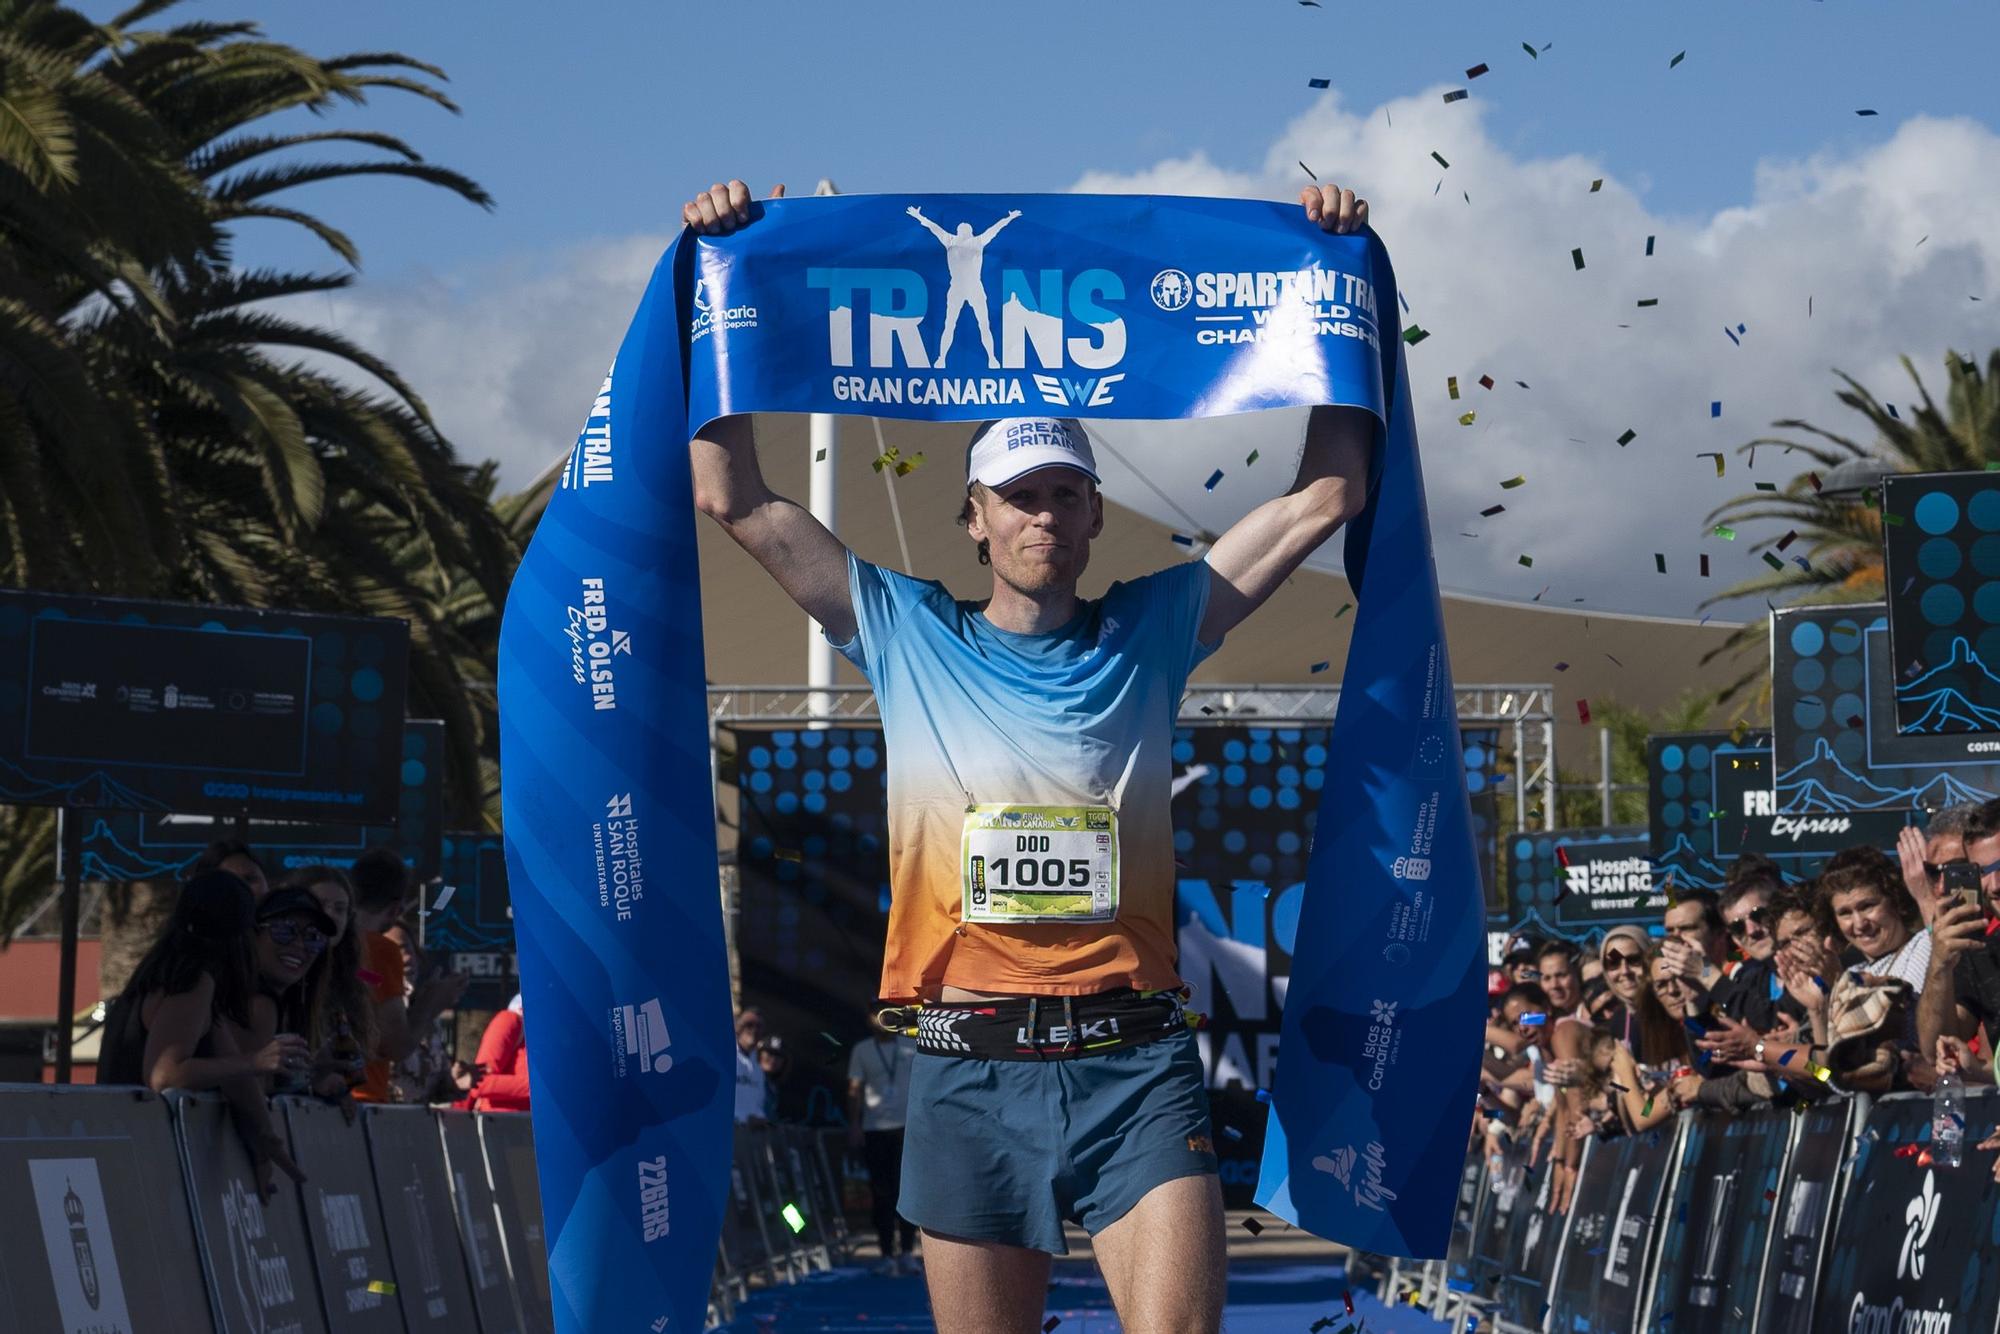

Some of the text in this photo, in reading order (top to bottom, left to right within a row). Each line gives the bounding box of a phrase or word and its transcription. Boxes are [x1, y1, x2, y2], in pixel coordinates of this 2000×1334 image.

[1195, 270, 1336, 308] SPARTAN
[832, 373, 1126, 407] GRAN CANARIA SWE
[1007, 422, 1071, 439] GREAT
[1007, 433, 1077, 451] BRITAIN
[583, 423, 613, 488] TRAIL
[564, 605, 588, 685] Express
[1967, 741, 2000, 753] COSTA
[1022, 812, 1044, 821] GRAN
[1023, 820, 1056, 829] CANARIA
[1410, 802, 1428, 855] Gobierno
[1425, 791, 1440, 841] Canarias
[1770, 815, 1851, 842] Express
[624, 819, 644, 901] Hospitales
[1016, 835, 1050, 852] DOD
[592, 822, 609, 908] UNIVERSITARIOS
[608, 821, 632, 922] SAN ROQUE
[990, 858, 1090, 887] 1005
[1590, 875, 1626, 894] SAN
[1386, 901, 1402, 940] Canarias
[1398, 905, 1411, 941] avanza
[1408, 891, 1423, 926] Europa
[612, 1006, 627, 1078] ExpoMeloneras
[1016, 1018, 1120, 1044] LEKI
[1362, 1025, 1380, 1058] Islas
[1368, 1027, 1393, 1090] Canarias
[638, 1155, 670, 1243] 226ERS
